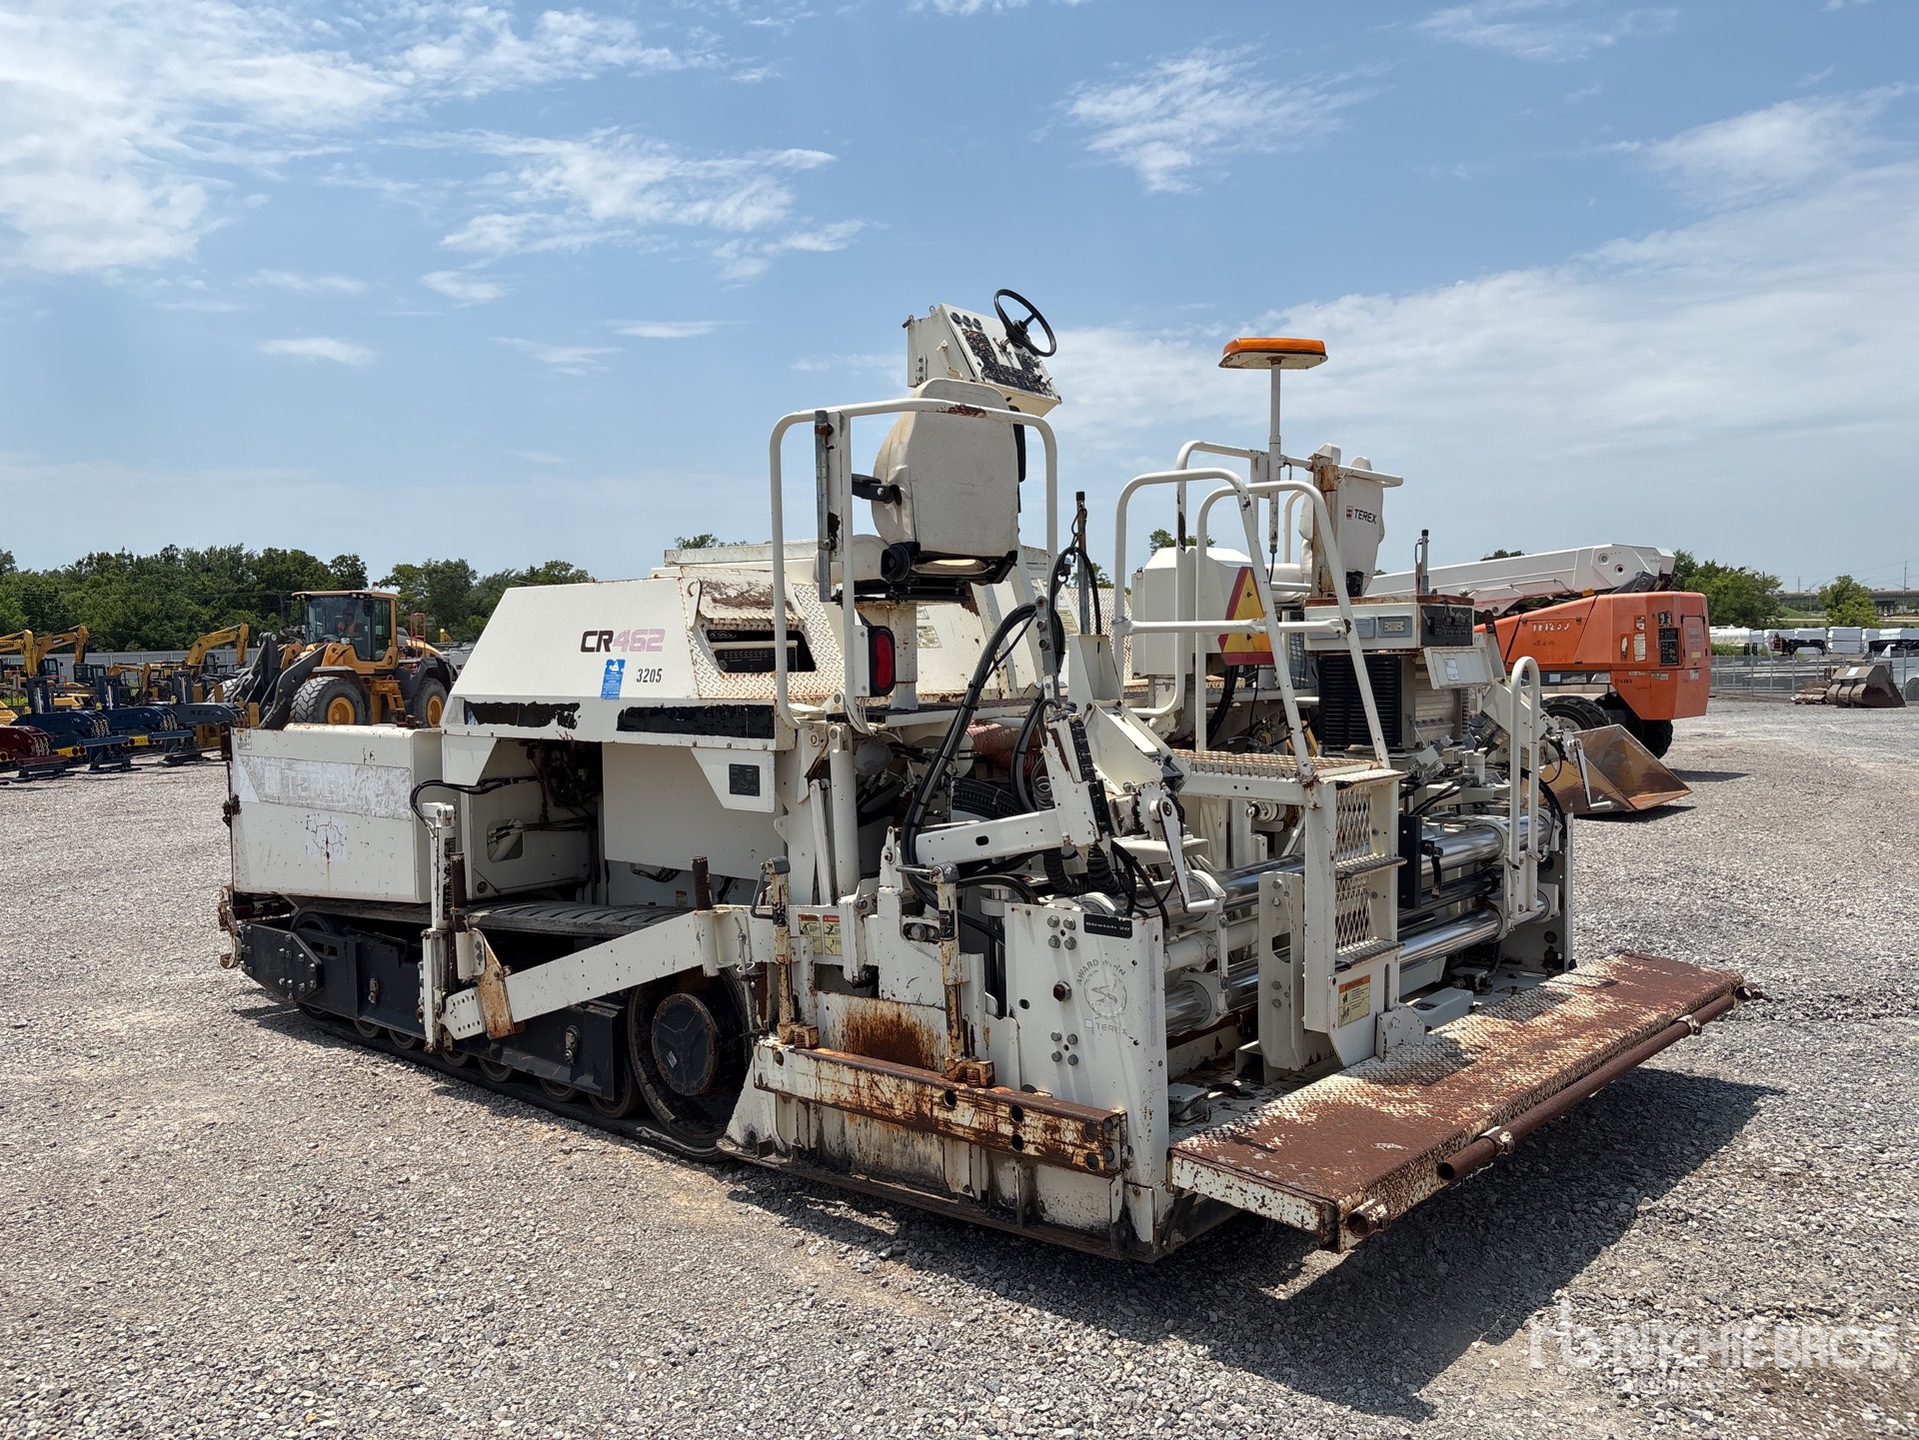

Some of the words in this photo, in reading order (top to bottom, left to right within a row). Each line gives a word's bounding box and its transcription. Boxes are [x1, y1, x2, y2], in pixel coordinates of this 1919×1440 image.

[1354, 509, 1377, 524] TEREX
[580, 628, 666, 653] CR462
[636, 668, 663, 684] 3205
